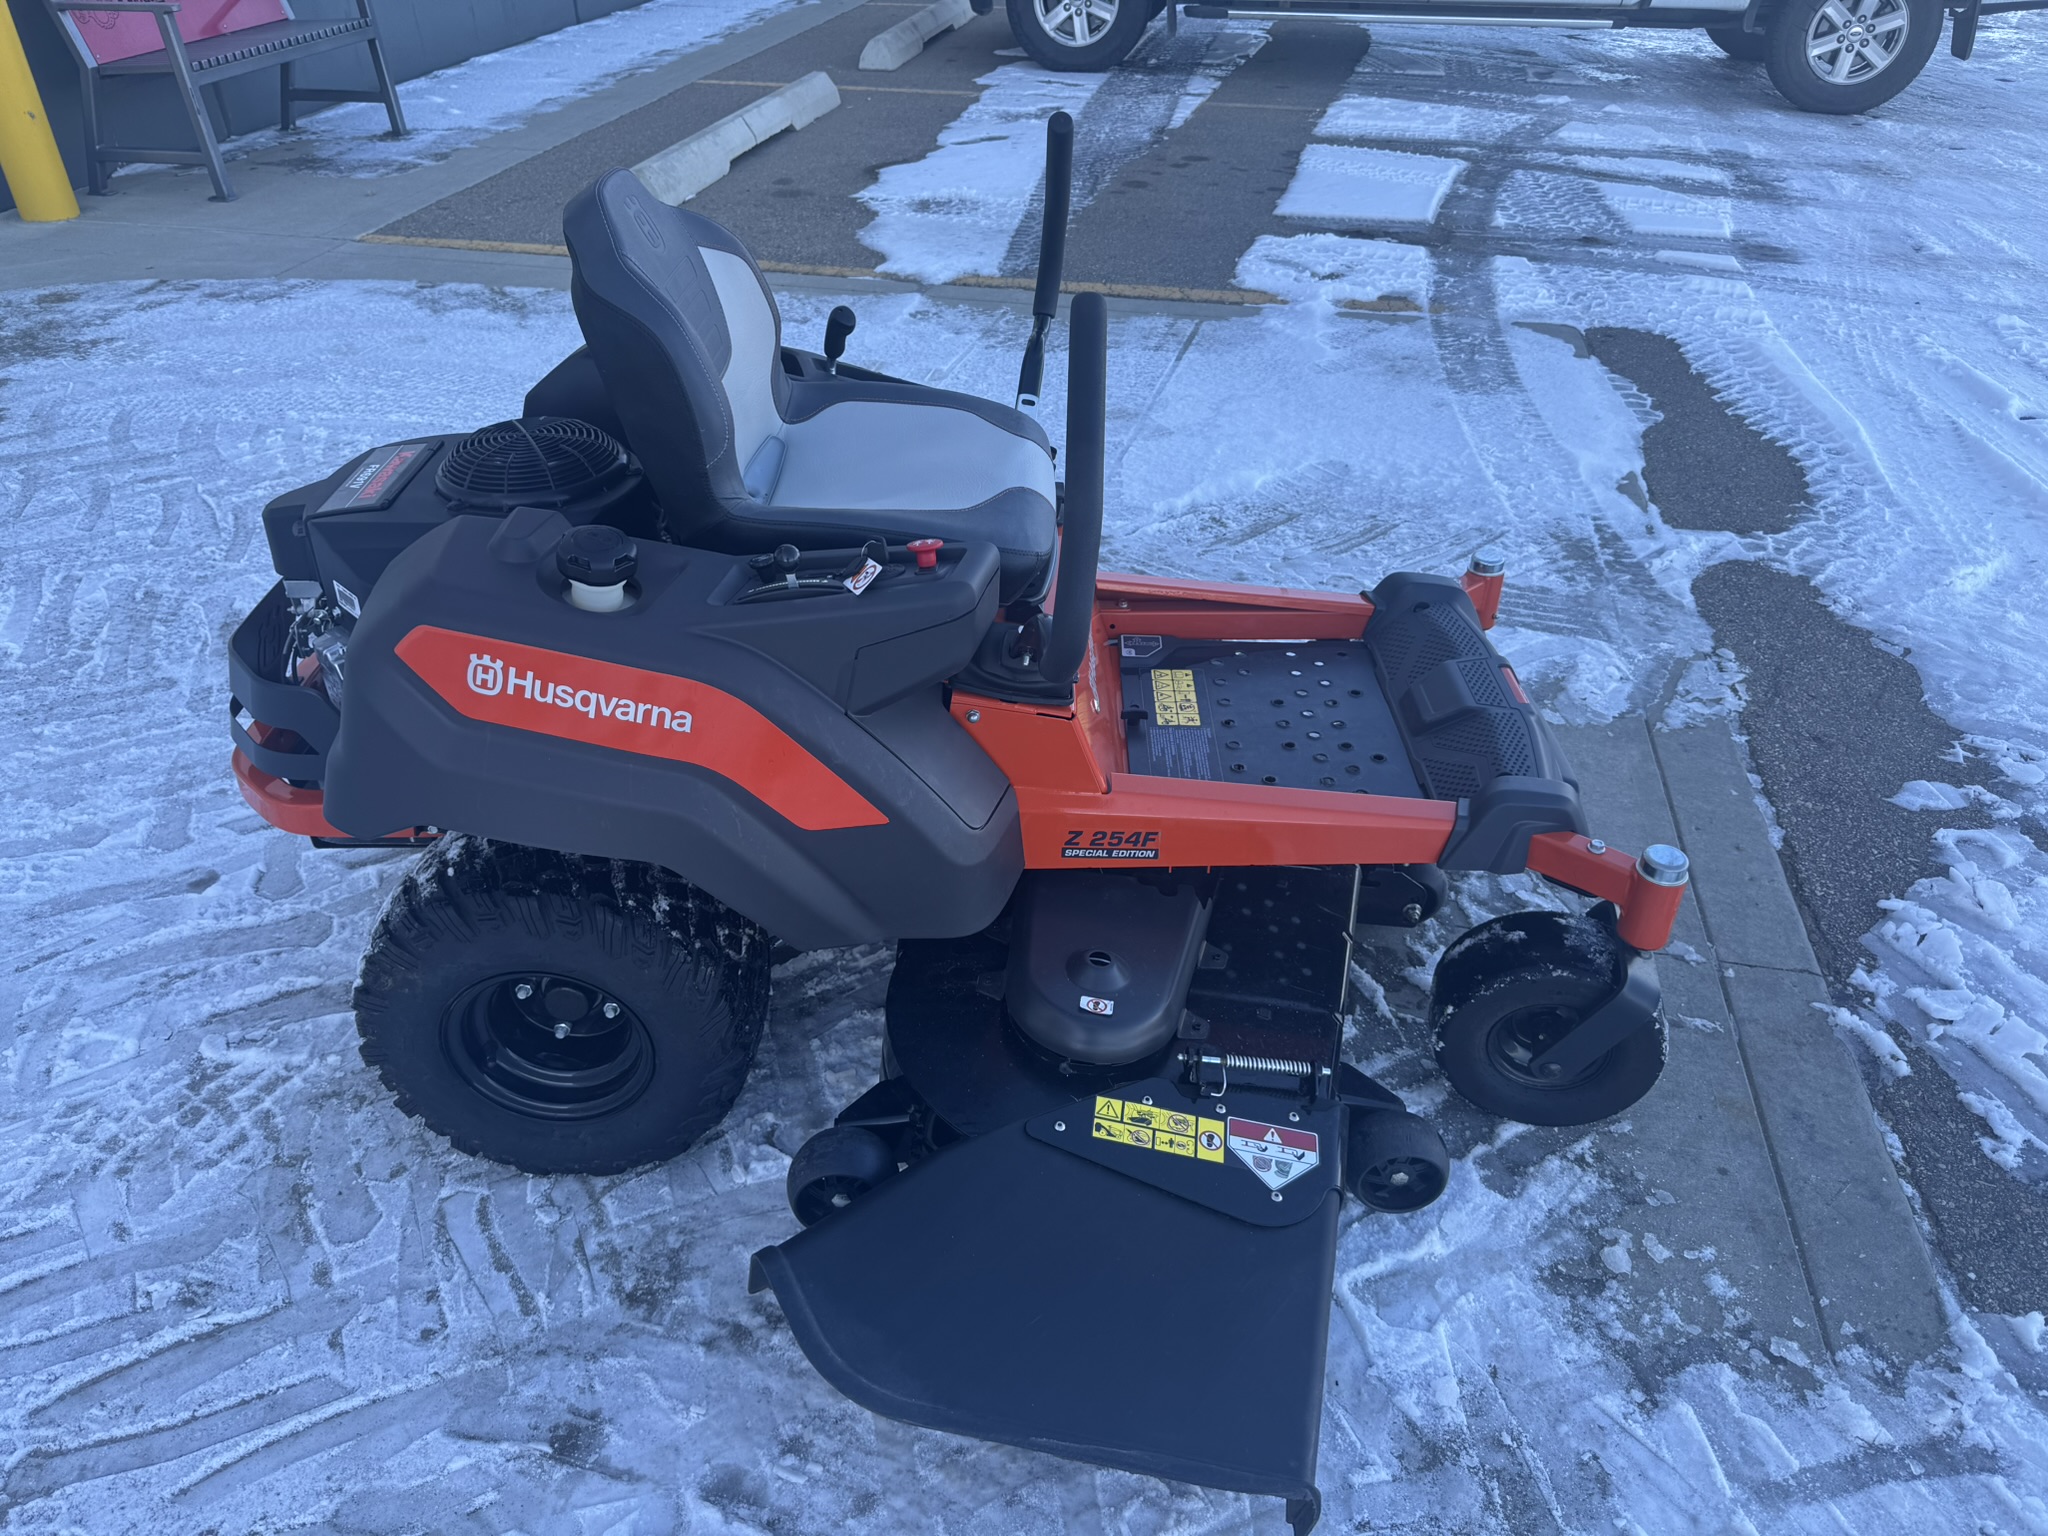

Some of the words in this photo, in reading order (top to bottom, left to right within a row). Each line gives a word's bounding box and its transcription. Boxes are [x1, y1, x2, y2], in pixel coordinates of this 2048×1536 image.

[357, 450, 416, 499] Kawasaki
[507, 667, 692, 733] Husqvarna
[1064, 831, 1083, 846] Z
[1089, 831, 1159, 847] 254F
[1065, 849, 1109, 857] SPECIAL
[1111, 850, 1155, 858] EDITION
